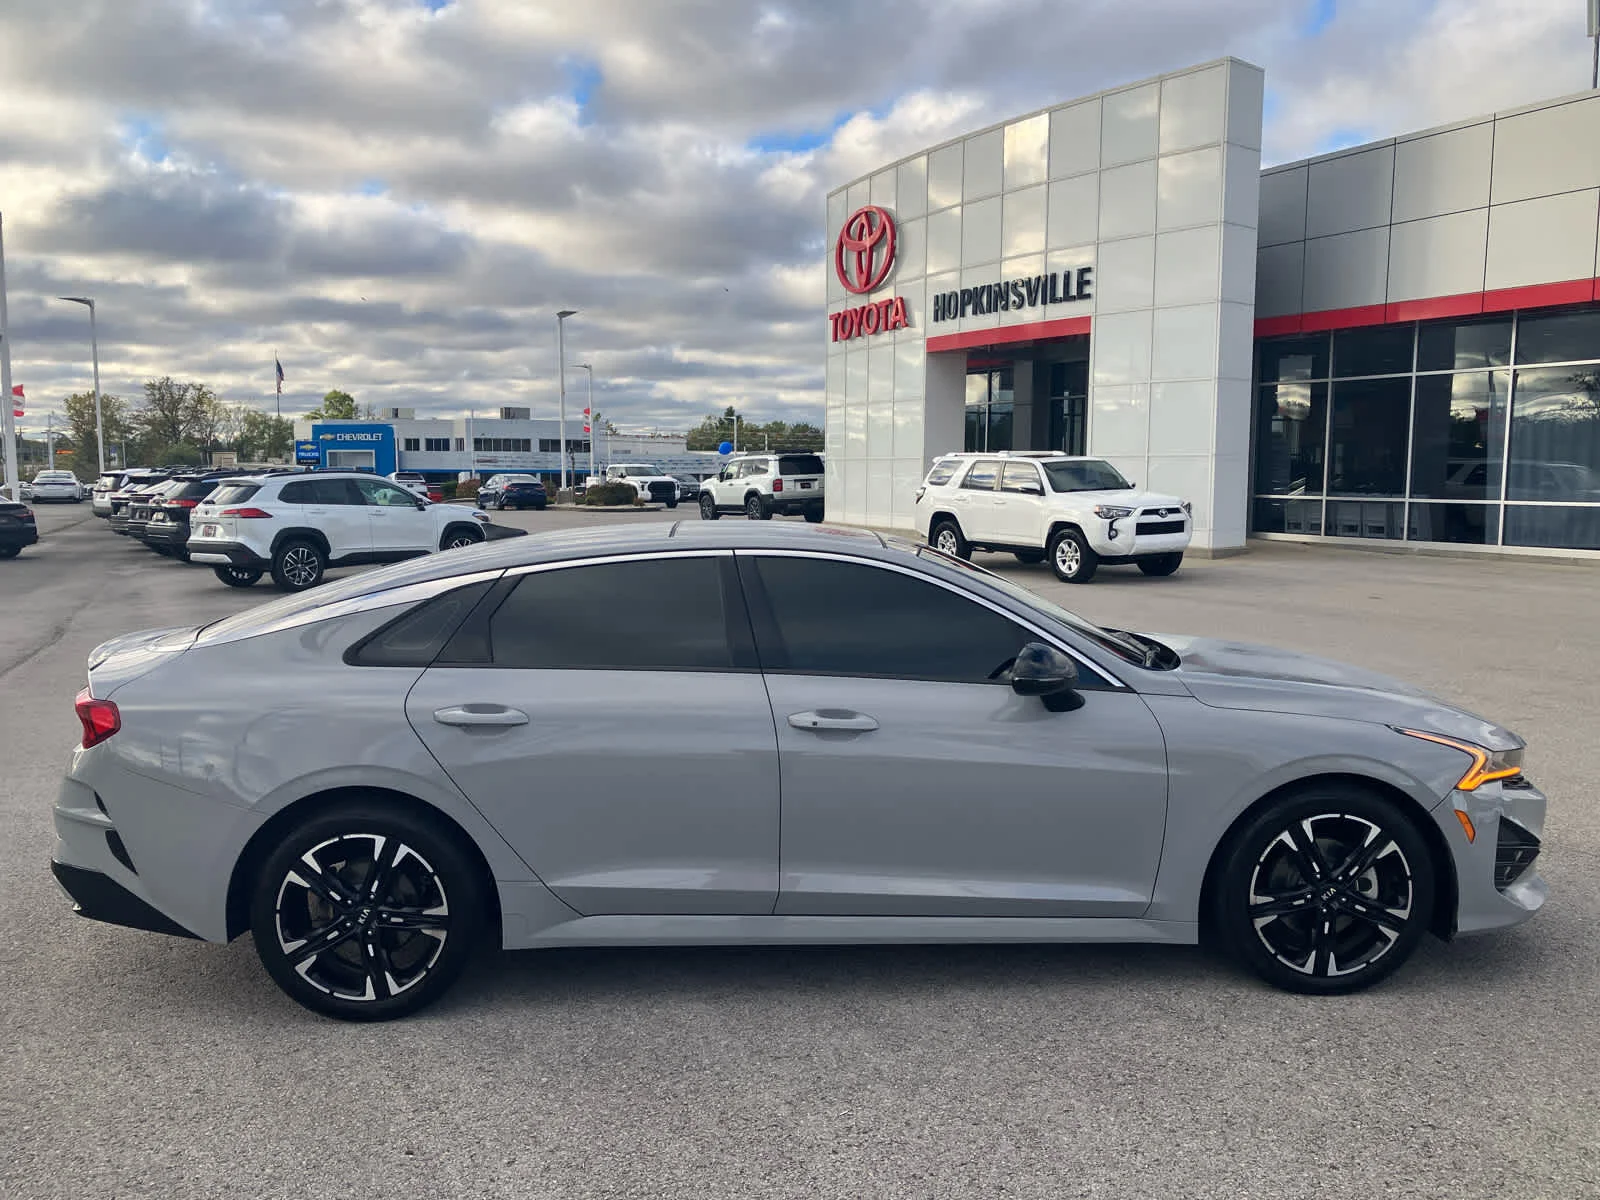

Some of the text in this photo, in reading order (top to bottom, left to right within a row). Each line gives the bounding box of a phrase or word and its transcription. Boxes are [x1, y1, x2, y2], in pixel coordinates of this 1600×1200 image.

[933, 267, 1092, 322] HOPKINSVILLE
[829, 296, 909, 343] TOYOTA
[336, 433, 383, 441] CHEVROLET
[1321, 887, 1337, 901] KIA
[358, 909, 371, 925] KIA
